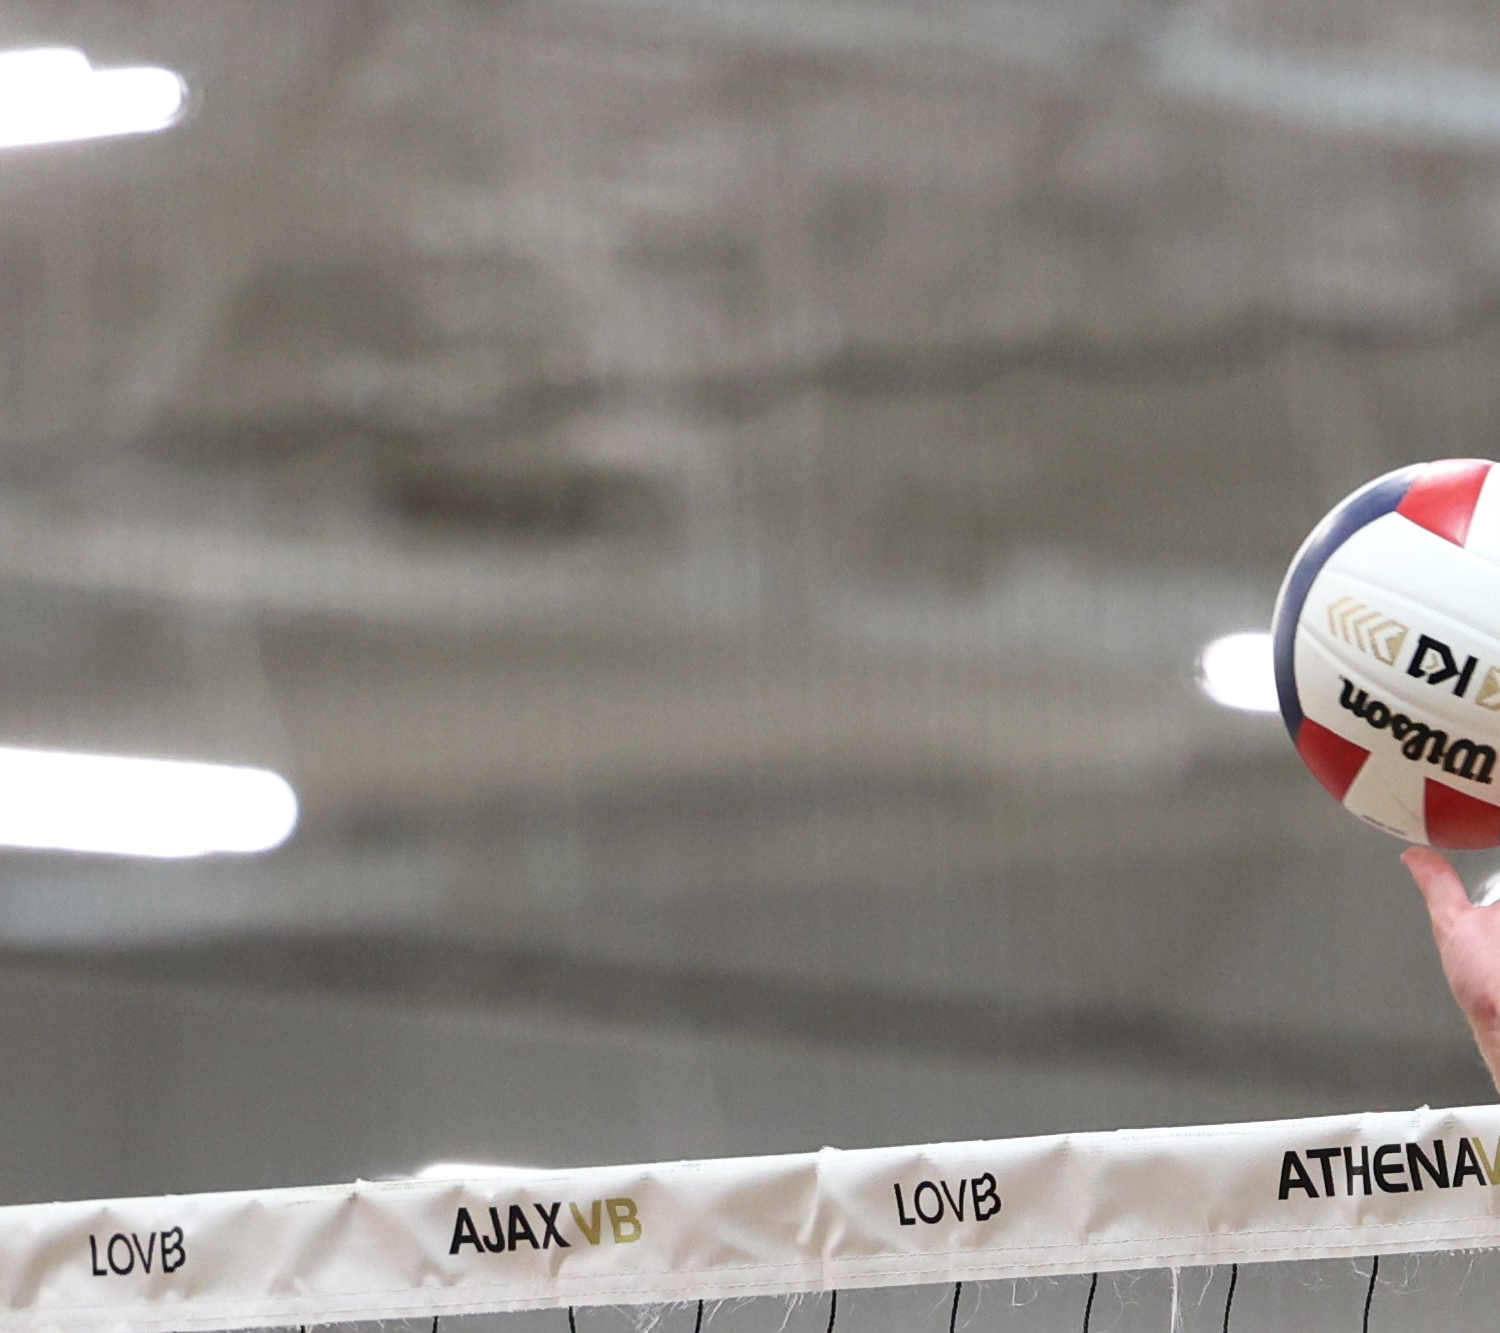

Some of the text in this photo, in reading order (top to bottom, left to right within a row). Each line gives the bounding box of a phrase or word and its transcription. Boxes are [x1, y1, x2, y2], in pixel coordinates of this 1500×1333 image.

[1338, 675, 1497, 785] Wilson
[89, 1226, 186, 1277] LOVB
[894, 1172, 1001, 1227] LOVB
